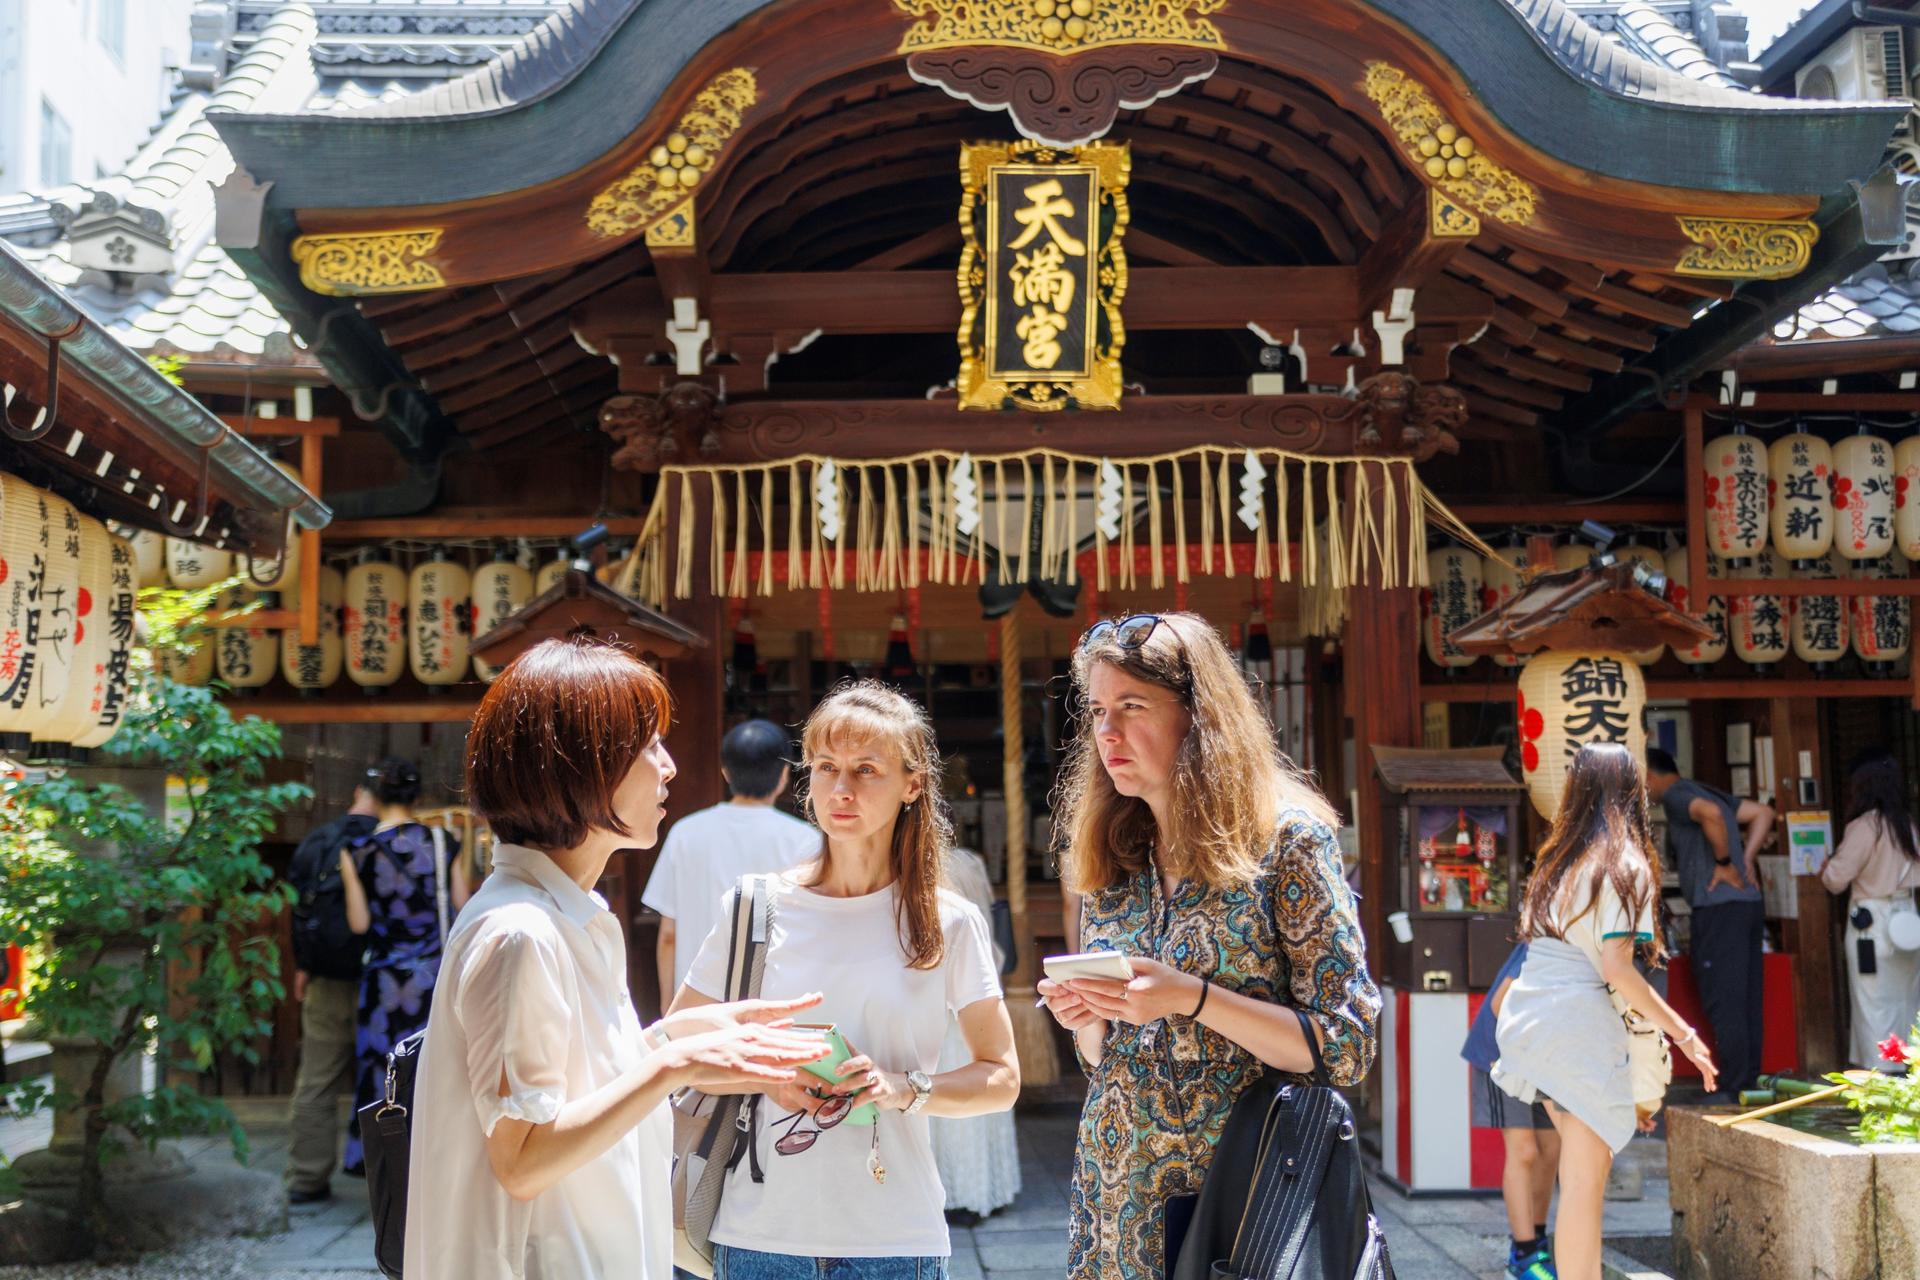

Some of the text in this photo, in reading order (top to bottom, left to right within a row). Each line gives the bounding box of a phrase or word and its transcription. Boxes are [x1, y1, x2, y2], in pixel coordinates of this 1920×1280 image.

[1008, 179, 1086, 369] 天満宮
[1784, 470, 1823, 541] 近新
[1861, 474, 1890, 540] 北尾
[1562, 656, 1630, 773] 錦天
